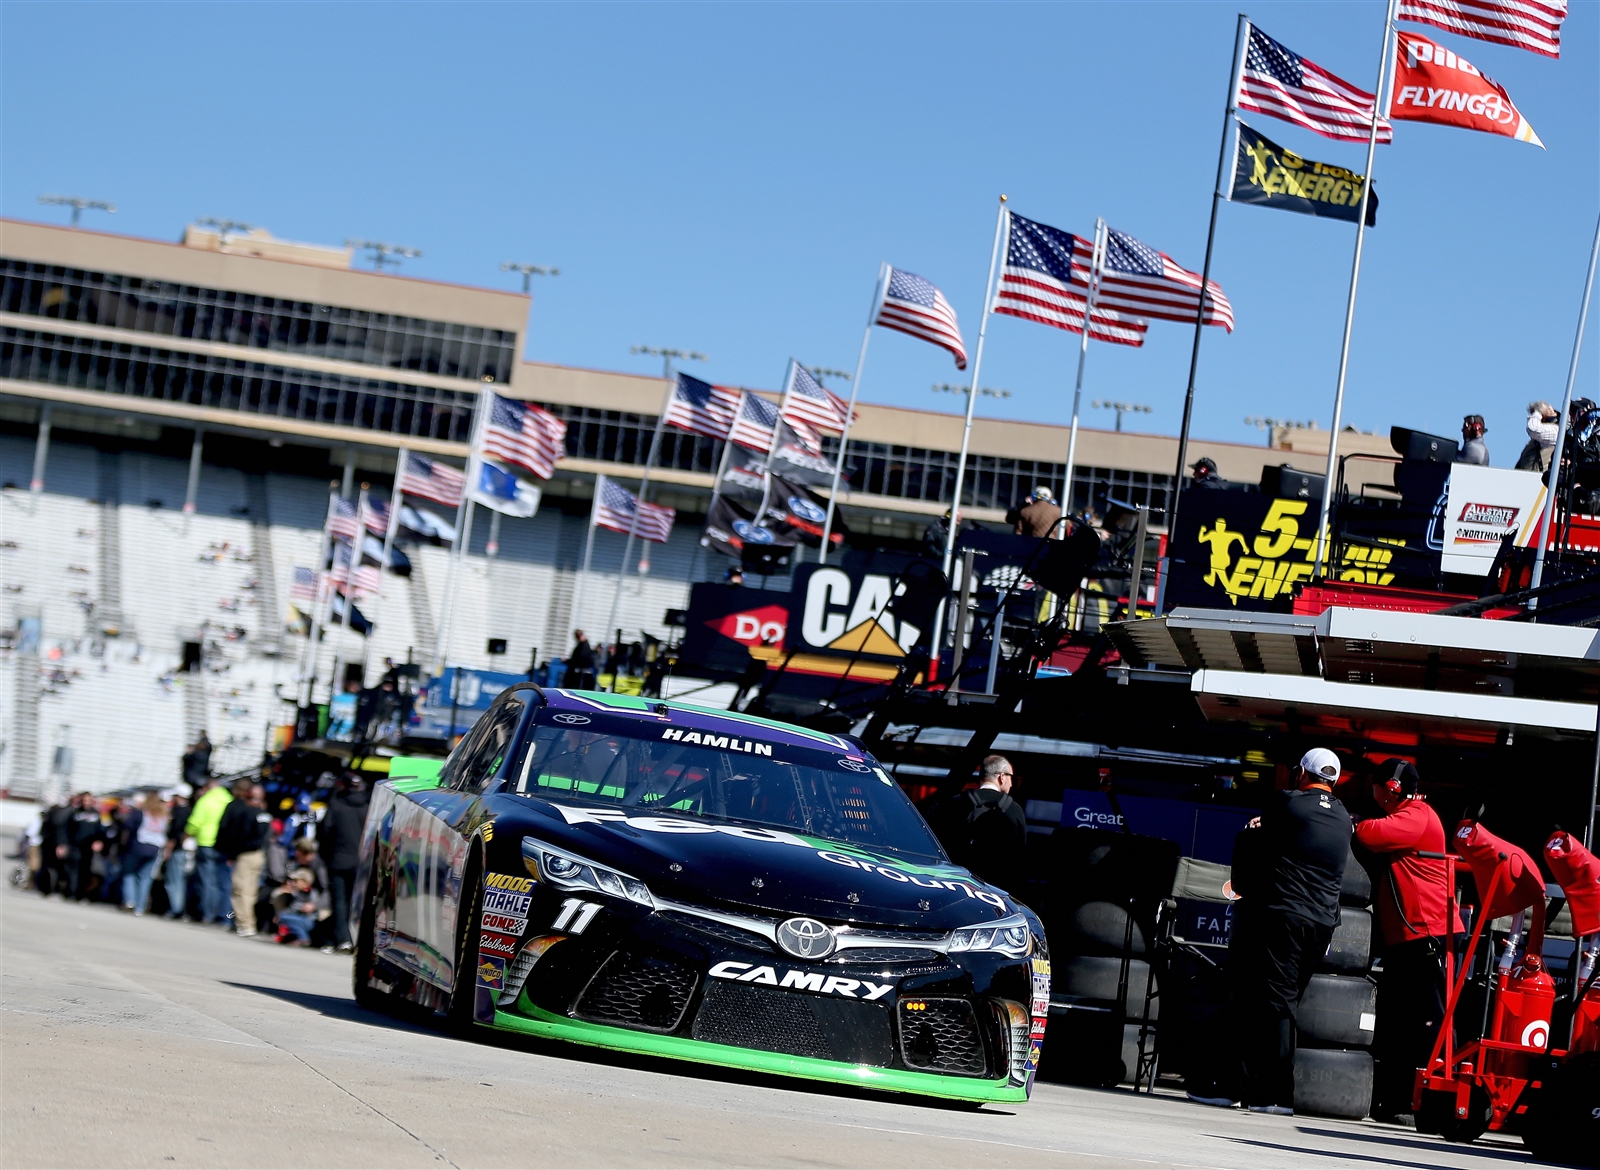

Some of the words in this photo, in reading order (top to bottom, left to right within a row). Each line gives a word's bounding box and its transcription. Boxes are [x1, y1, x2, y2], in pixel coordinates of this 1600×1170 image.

[1407, 40, 1481, 77] Pilo
[1265, 166, 1365, 207] ENERGY
[661, 728, 773, 757] HAMLIN
[1074, 807, 1124, 826] Great
[484, 872, 533, 894] MOOG
[817, 850, 1007, 912] Ground
[485, 891, 531, 914] MAHLE
[483, 914, 516, 929] COMP
[551, 898, 604, 935] 11
[480, 934, 515, 954] Edelbrock
[477, 966, 503, 979] SUNOCO
[708, 961, 894, 1001] CAMRY
